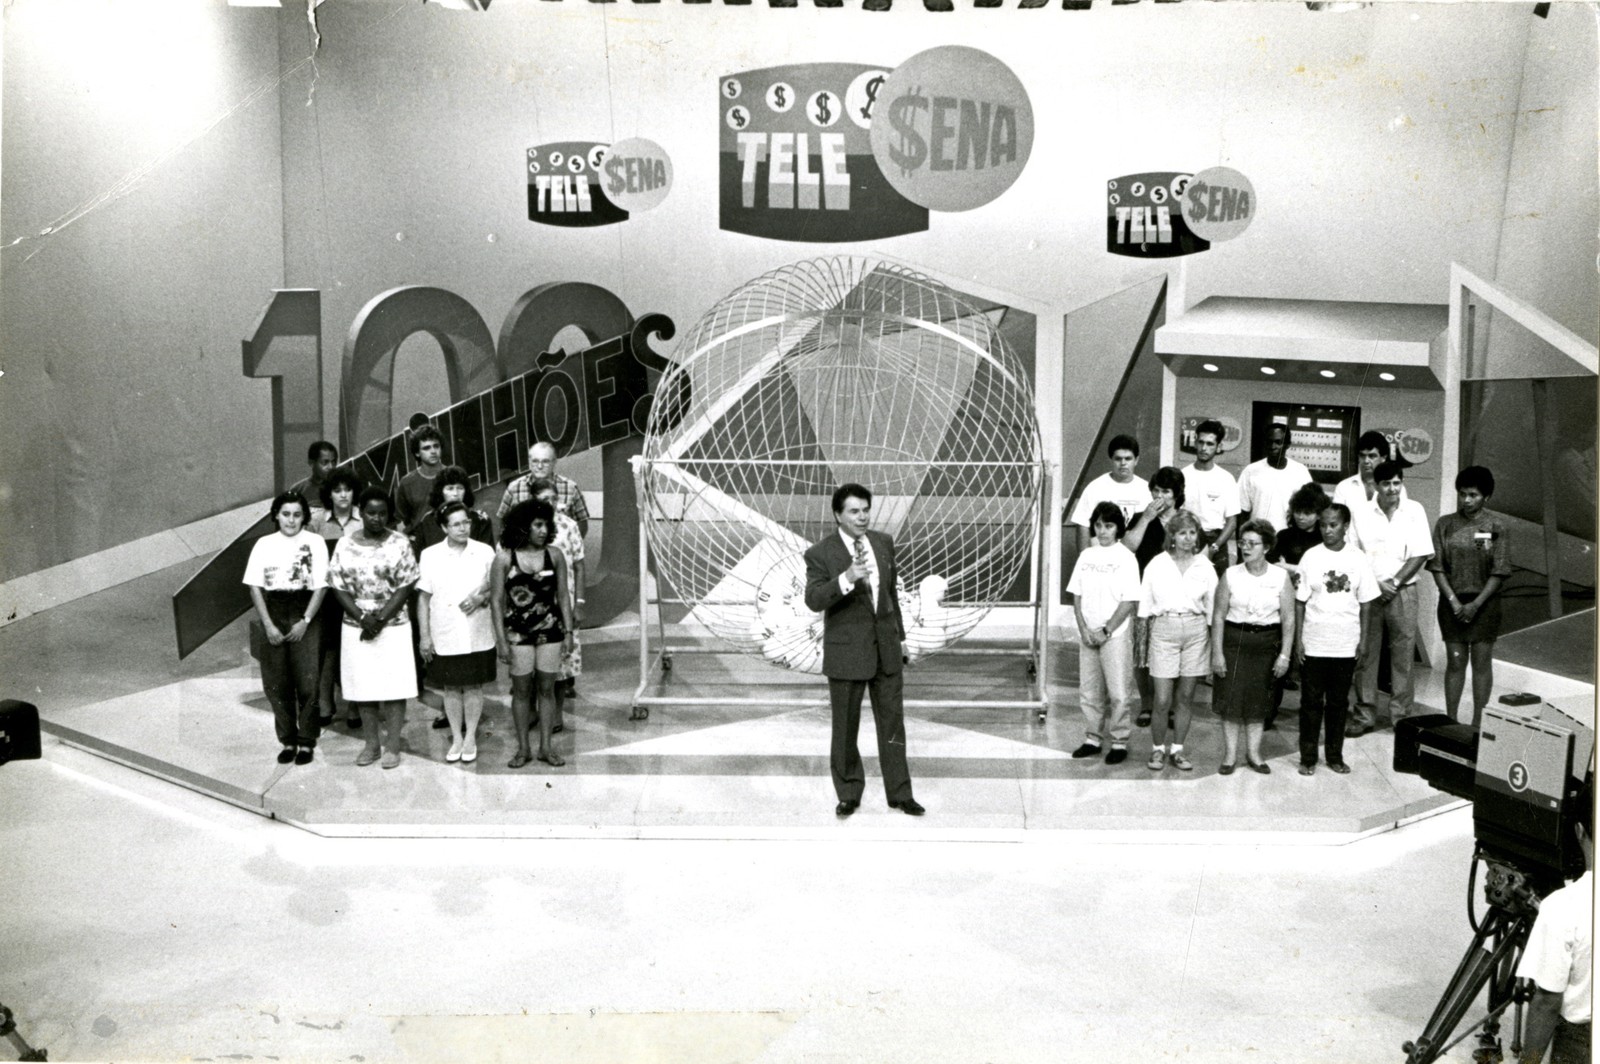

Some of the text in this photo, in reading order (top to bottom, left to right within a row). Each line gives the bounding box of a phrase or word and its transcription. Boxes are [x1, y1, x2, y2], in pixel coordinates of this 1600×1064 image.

[737, 132, 851, 210] TELE
[535, 175, 592, 213] TELE
[1115, 206, 1173, 244] TELE
[350, 311, 692, 498] MLHÕES
[1513, 766, 1524, 786] 3
